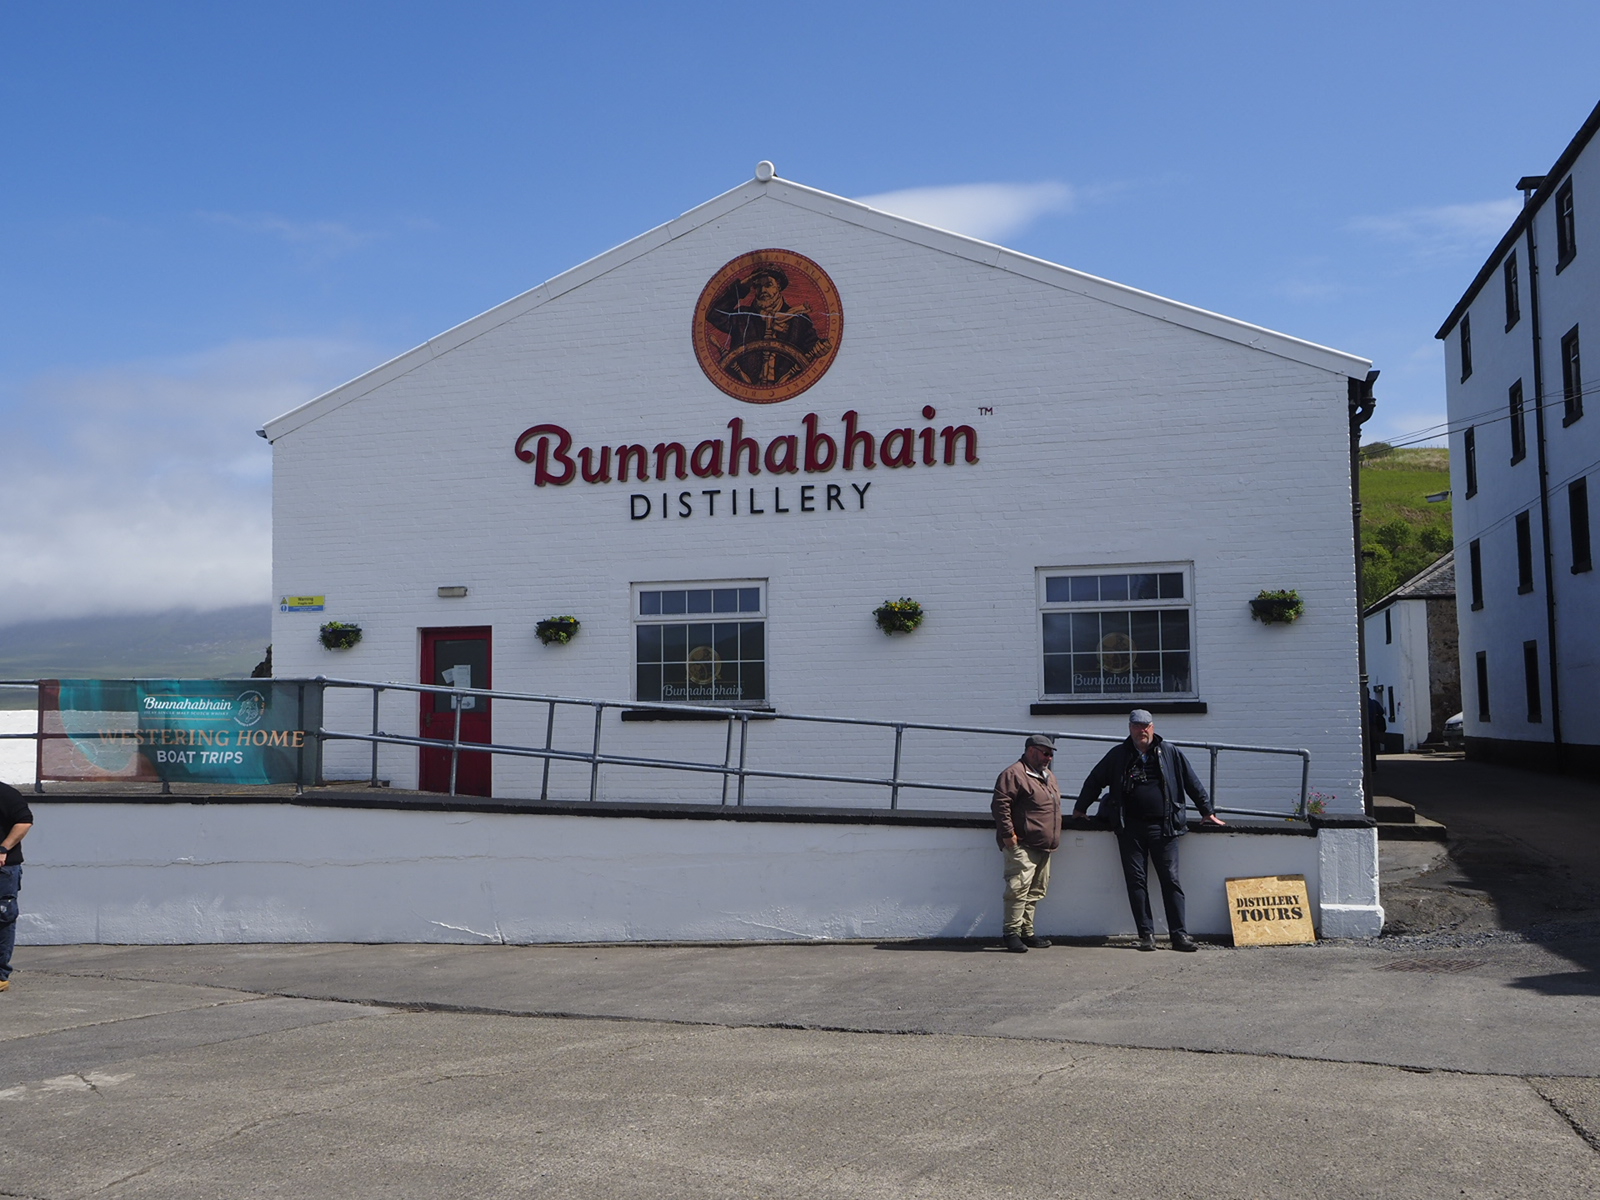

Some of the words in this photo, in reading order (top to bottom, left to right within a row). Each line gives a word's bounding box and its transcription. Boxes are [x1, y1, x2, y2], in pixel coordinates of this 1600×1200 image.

[795, 258, 824, 282] MALT
[695, 320, 759, 398] BUNNAHABHAIN
[785, 359, 826, 394] WHISKY
[514, 405, 979, 487] Bunnahabhain
[630, 482, 872, 520] DISTILLERY
[143, 696, 233, 711] Bunnahabhain
[99, 728, 230, 747] WESTERING
[235, 729, 305, 748] HOME
[156, 750, 195, 764] BOAT
[200, 751, 244, 764] TRIPS
[1236, 894, 1300, 908] DISTILLERY
[1237, 906, 1303, 922] TOURS
